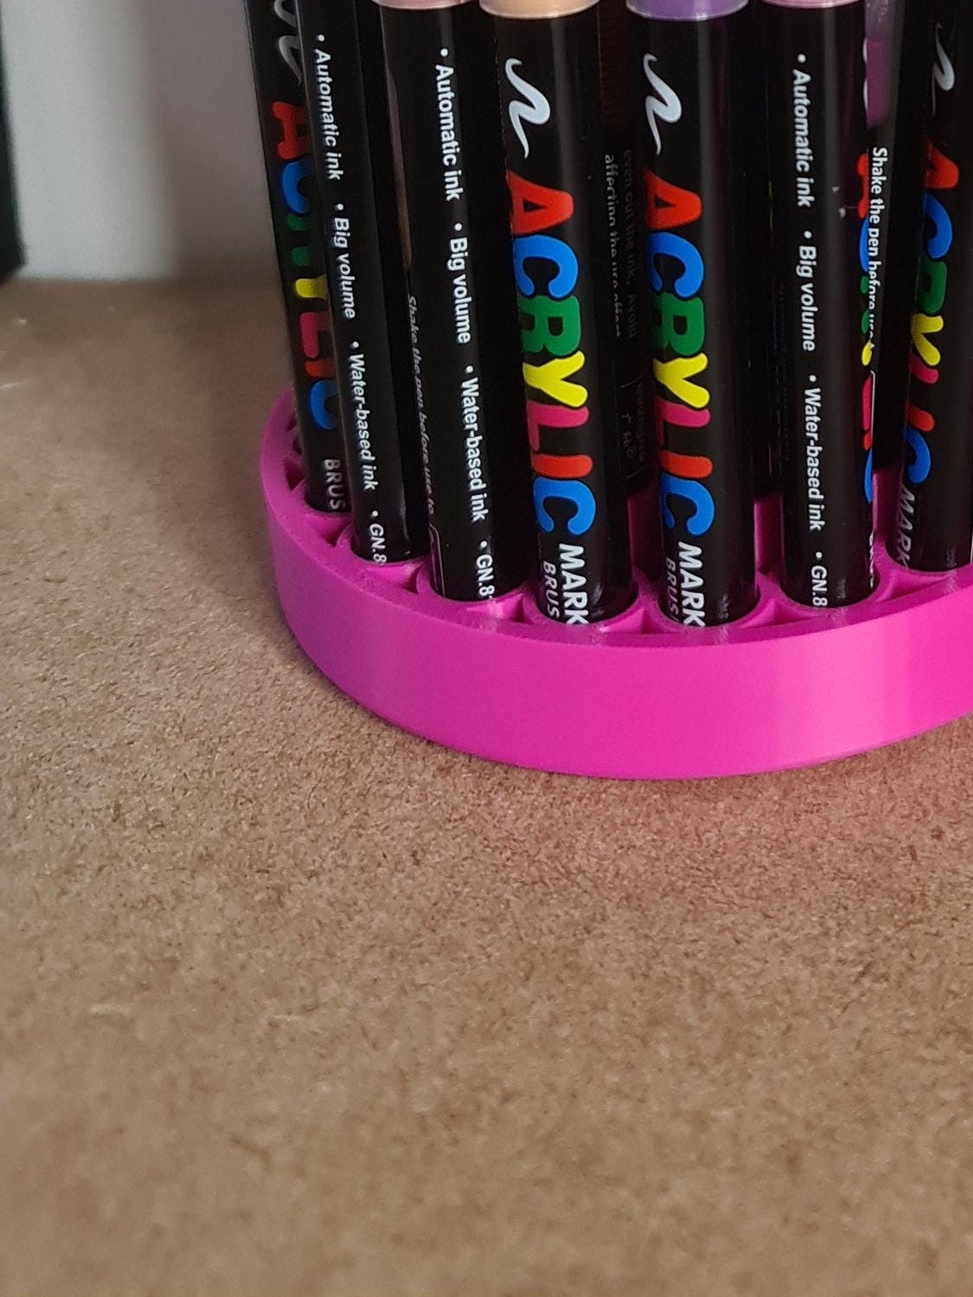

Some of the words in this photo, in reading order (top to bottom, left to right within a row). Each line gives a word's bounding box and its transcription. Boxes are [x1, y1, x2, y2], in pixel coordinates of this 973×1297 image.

[315, 49, 338, 146] Automatic
[434, 65, 457, 166] Automatic
[792, 69, 812, 172] Automatic
[325, 151, 344, 181] ink
[444, 170, 463, 200] ink
[797, 177, 816, 207] ink
[871, 147, 888, 195] Shake
[332, 217, 351, 247] Big
[869, 198, 885, 224] the
[446, 238, 468, 271] Big
[797, 245, 818, 279] Big
[338, 252, 357, 318] volume
[453, 275, 473, 343] volume
[801, 283, 819, 350] volume
[506, 171, 596, 535] ACRYLIC
[643, 167, 715, 536] ACRYLIC
[349, 353, 373, 460] Water-based
[461, 378, 485, 490] Water-based
[803, 388, 824, 498] Water-based
[362, 464, 379, 490] ink
[470, 494, 490, 522] ink
[808, 503, 826, 530] ink
